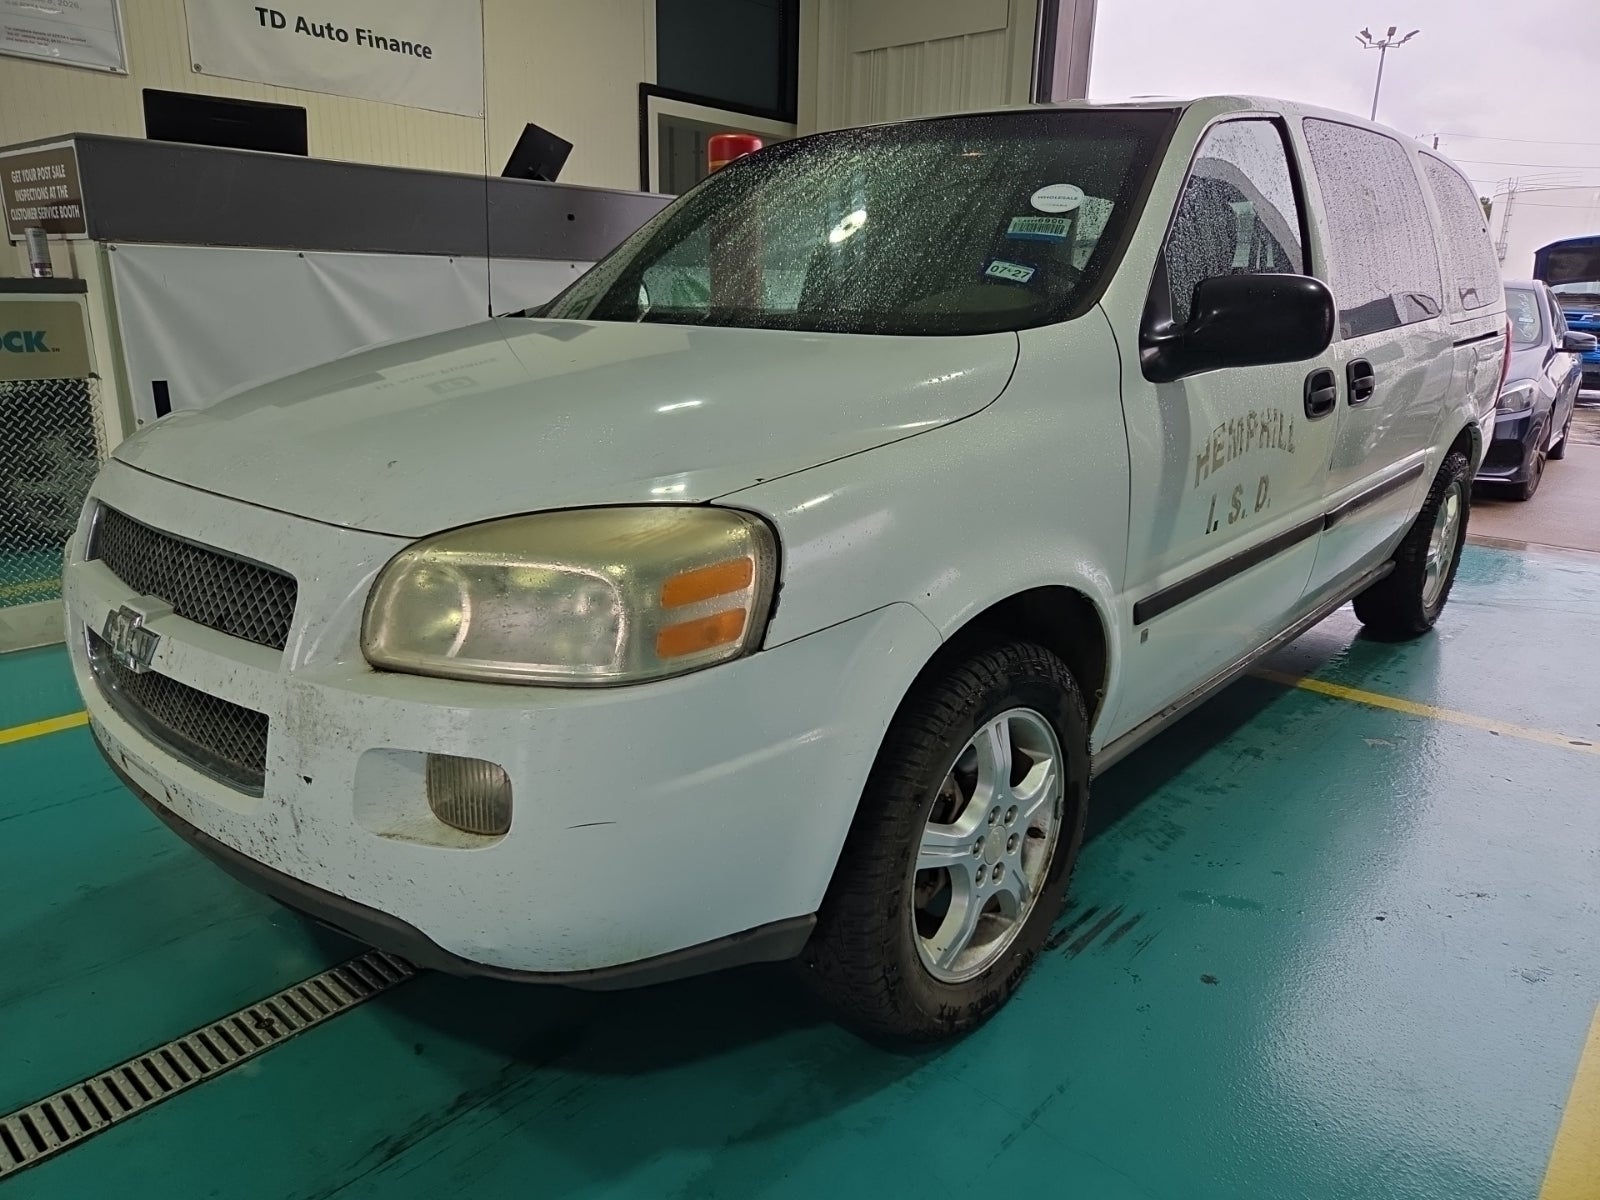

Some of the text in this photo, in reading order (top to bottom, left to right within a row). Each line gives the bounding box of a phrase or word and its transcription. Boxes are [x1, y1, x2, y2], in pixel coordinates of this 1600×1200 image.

[254, 6, 433, 59] TD Auto Finance
[11, 164, 66, 183] GET YOUR POST SALE
[14, 184, 68, 202] INSPECTIONS AT THE
[10, 204, 80, 220] CUSTOMER SERVICE BOOTH
[0, 330, 50, 353] CK
[1194, 407, 1296, 489] HEMPHILL
